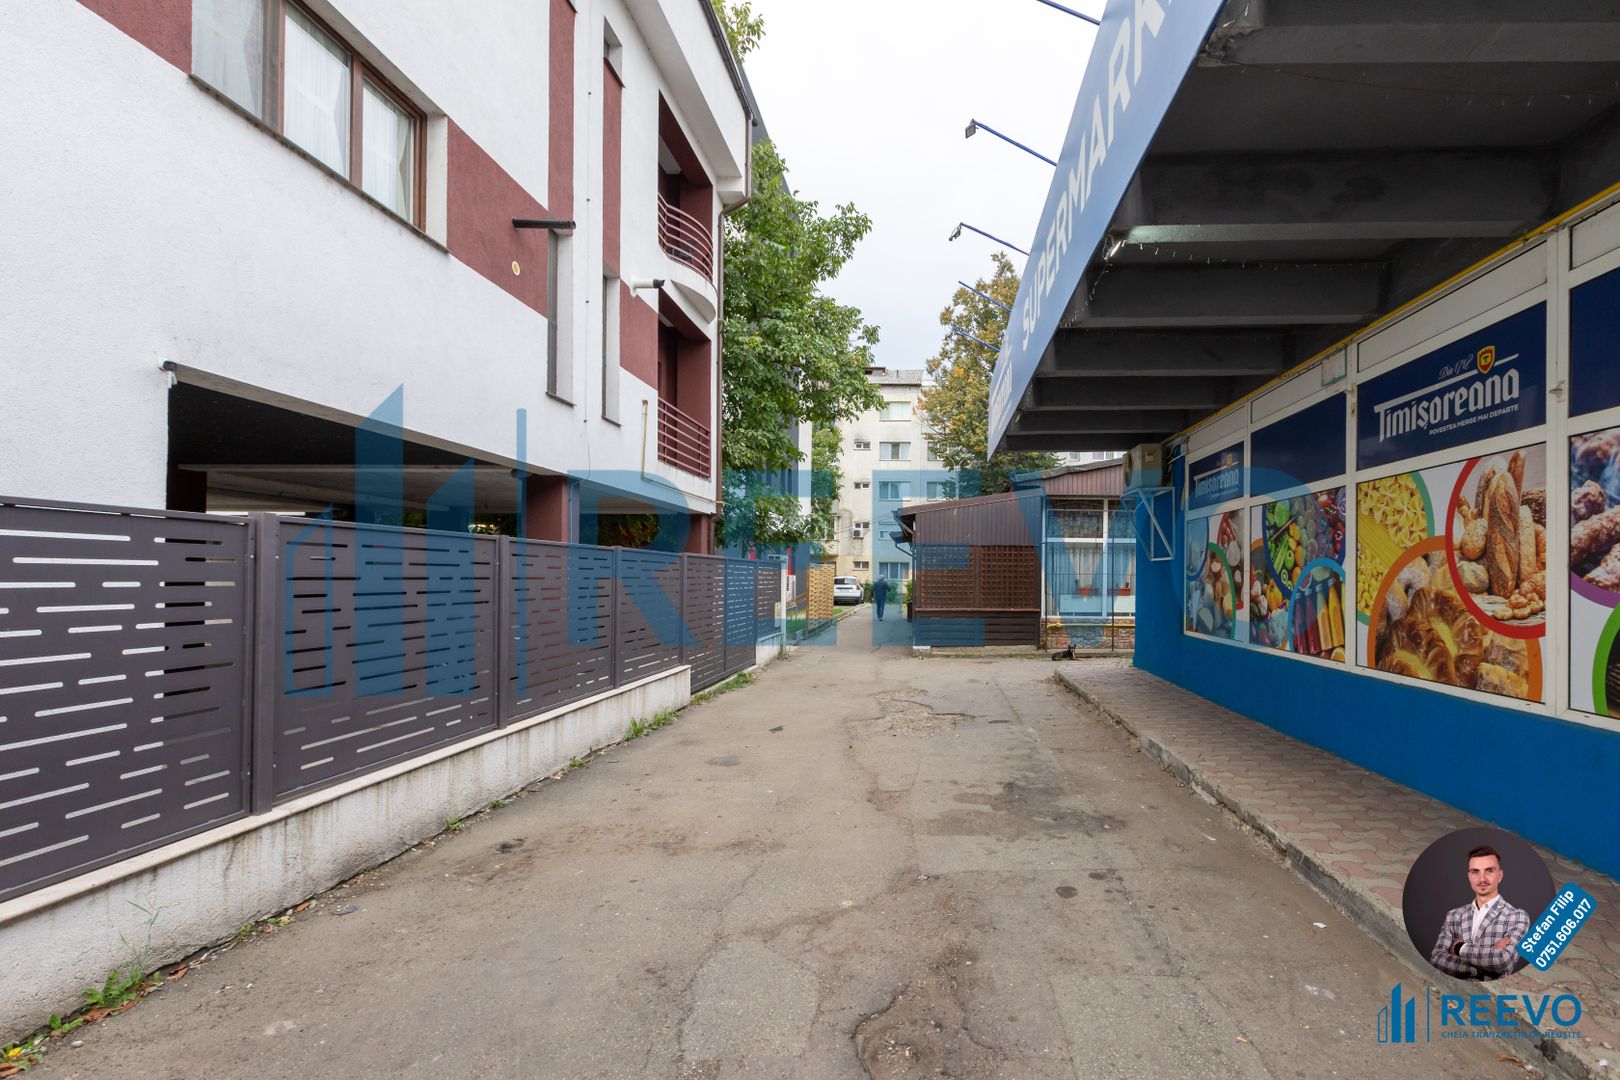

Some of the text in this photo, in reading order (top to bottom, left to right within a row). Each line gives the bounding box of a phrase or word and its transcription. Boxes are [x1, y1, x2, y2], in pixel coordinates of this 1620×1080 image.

[1022, 0, 1171, 352] SUPERMARK
[1429, 423, 1457, 436] POVESTEA
[1477, 413, 1489, 422] MAI
[1489, 404, 1520, 418] DEPARTE
